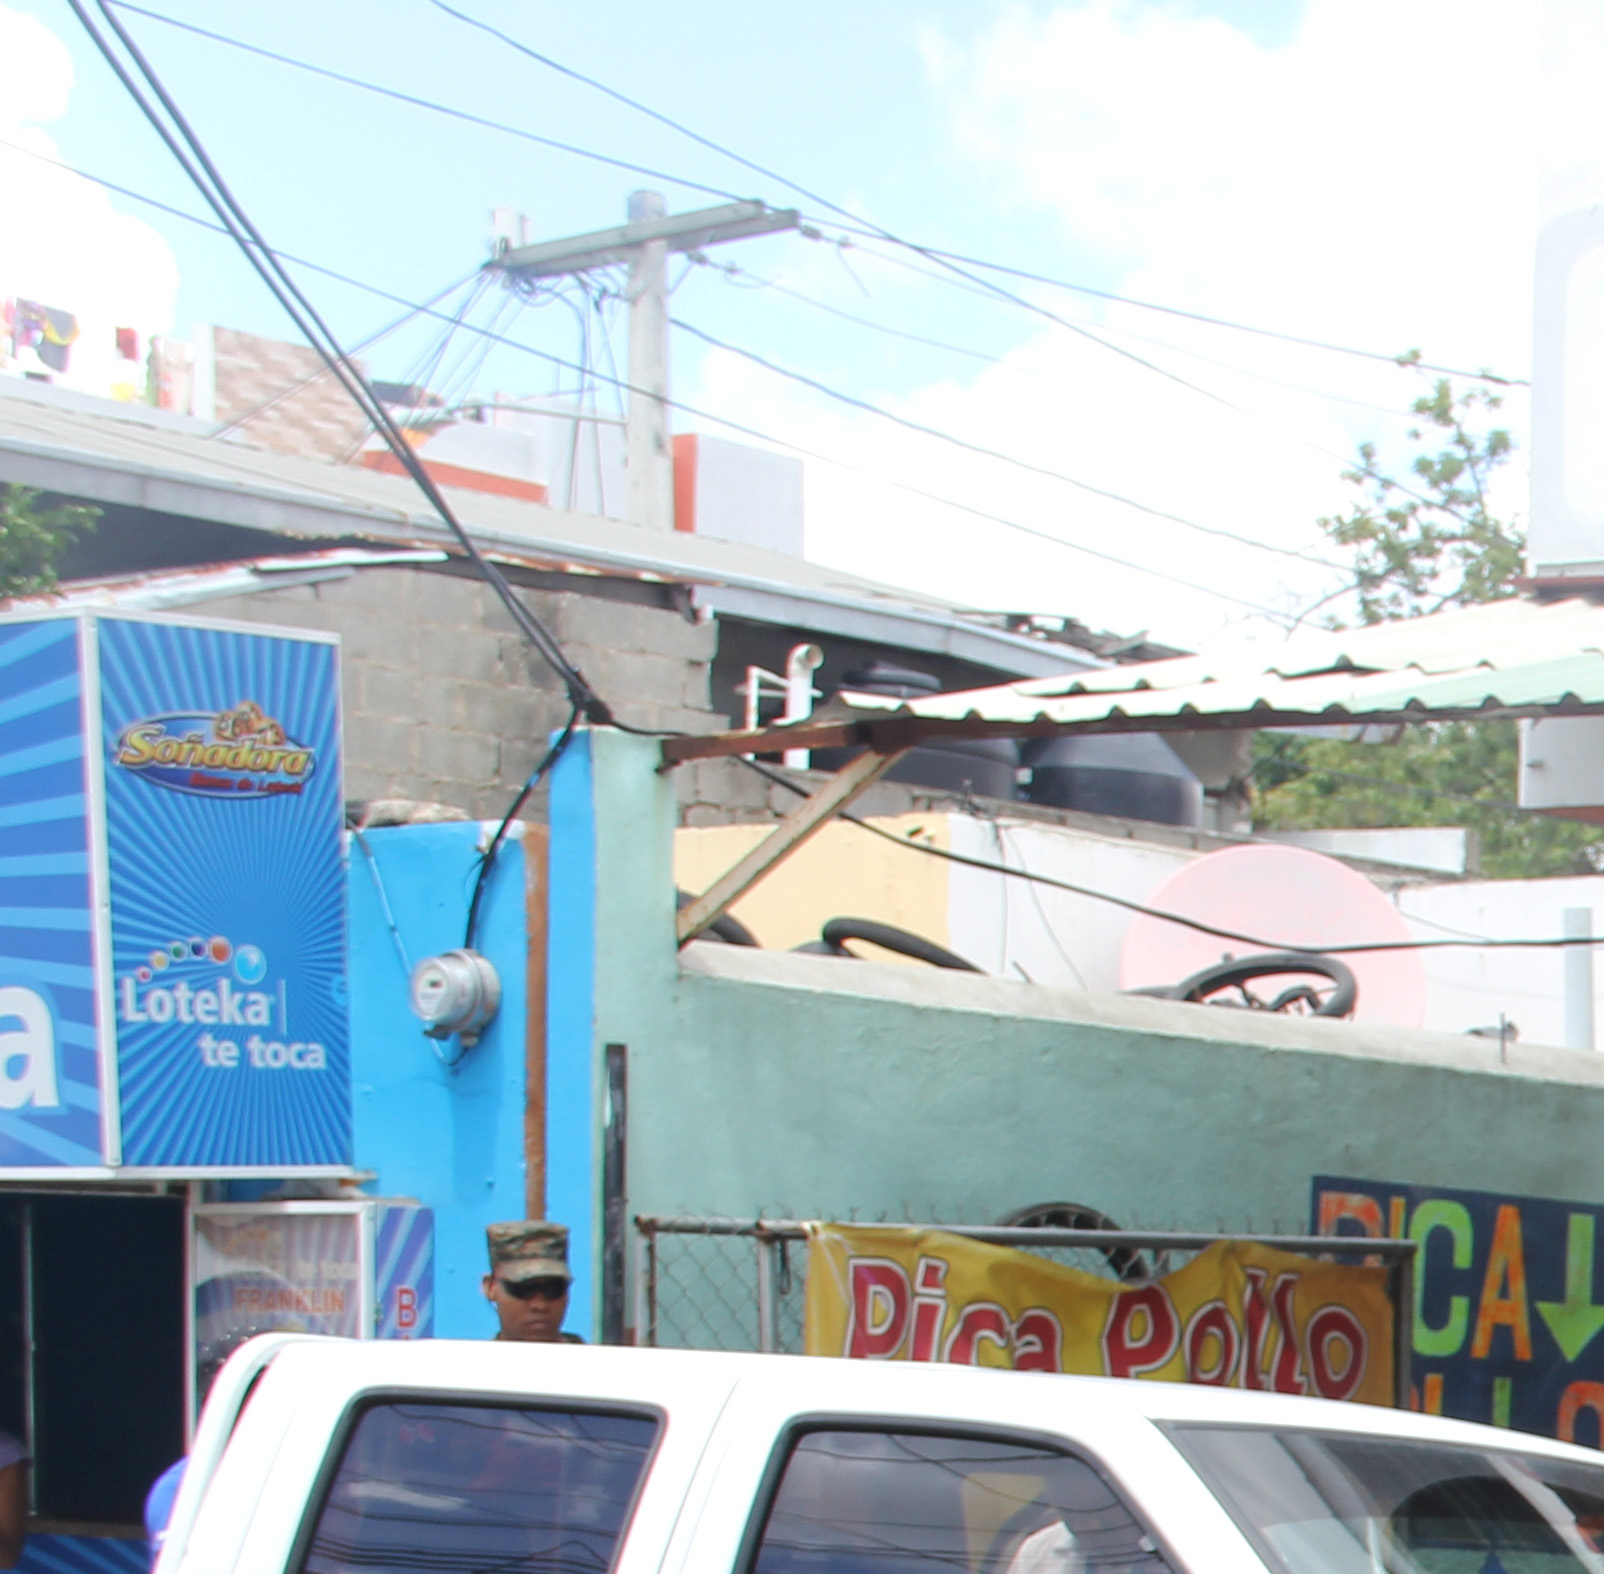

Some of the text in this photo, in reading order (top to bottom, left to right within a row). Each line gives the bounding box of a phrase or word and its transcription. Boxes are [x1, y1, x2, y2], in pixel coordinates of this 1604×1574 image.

[120, 976, 272, 1026] Loteka
[200, 1034, 328, 1070] te toca
